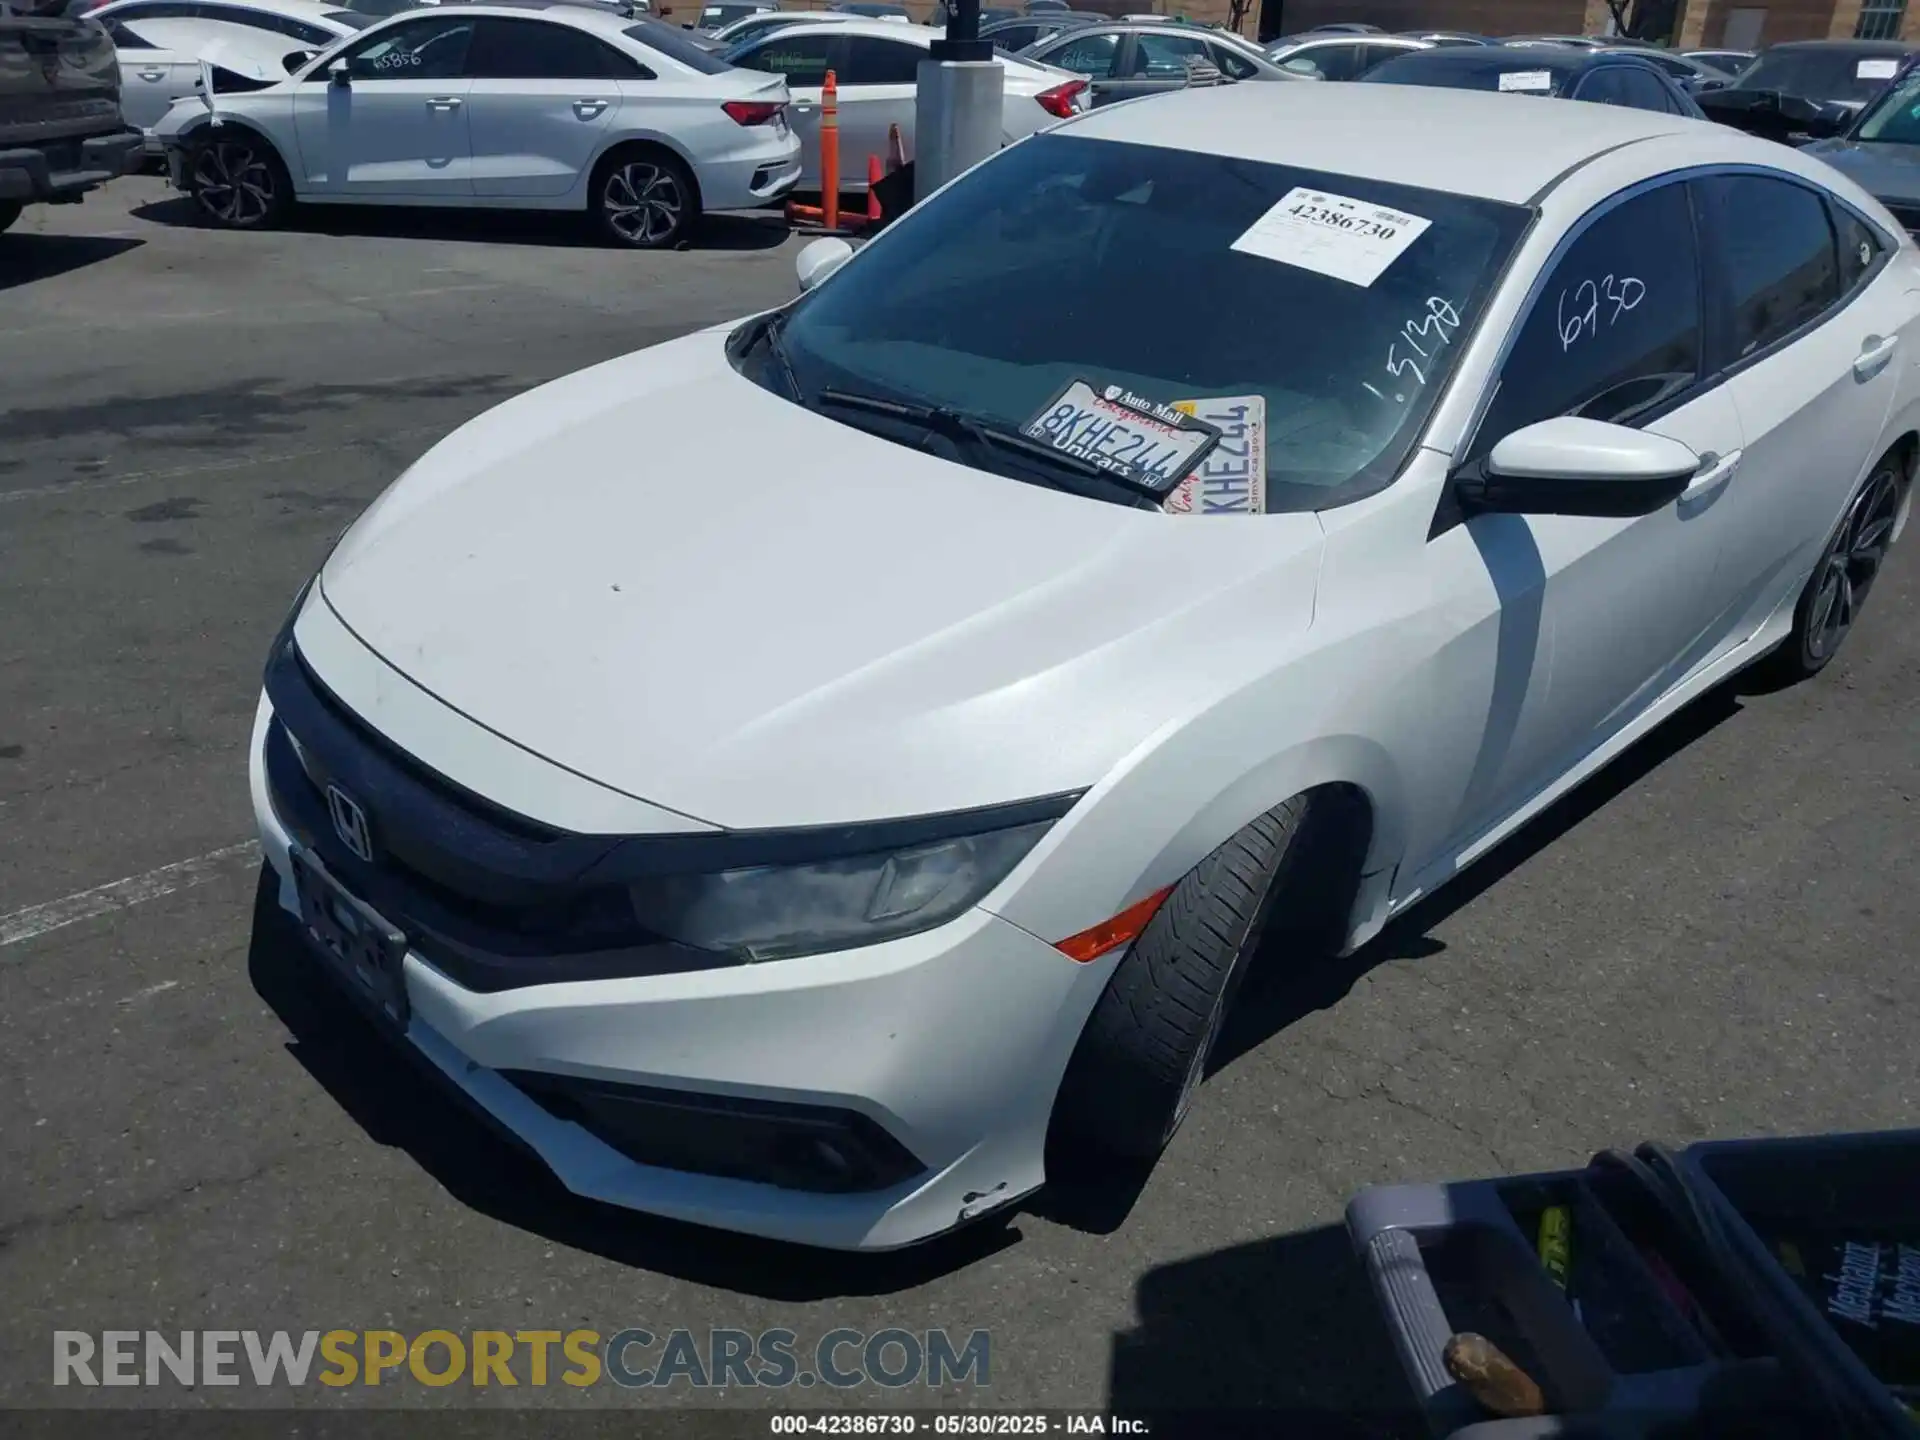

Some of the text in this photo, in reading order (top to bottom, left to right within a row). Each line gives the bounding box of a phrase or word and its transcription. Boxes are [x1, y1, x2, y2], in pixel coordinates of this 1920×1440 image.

[1288, 203, 1397, 240] 42386730
[1119, 391, 1151, 411] Auto
[1152, 403, 1184, 425] Mall
[1043, 403, 1179, 478] 8KHE244
[1052, 430, 1134, 477] Unicars
